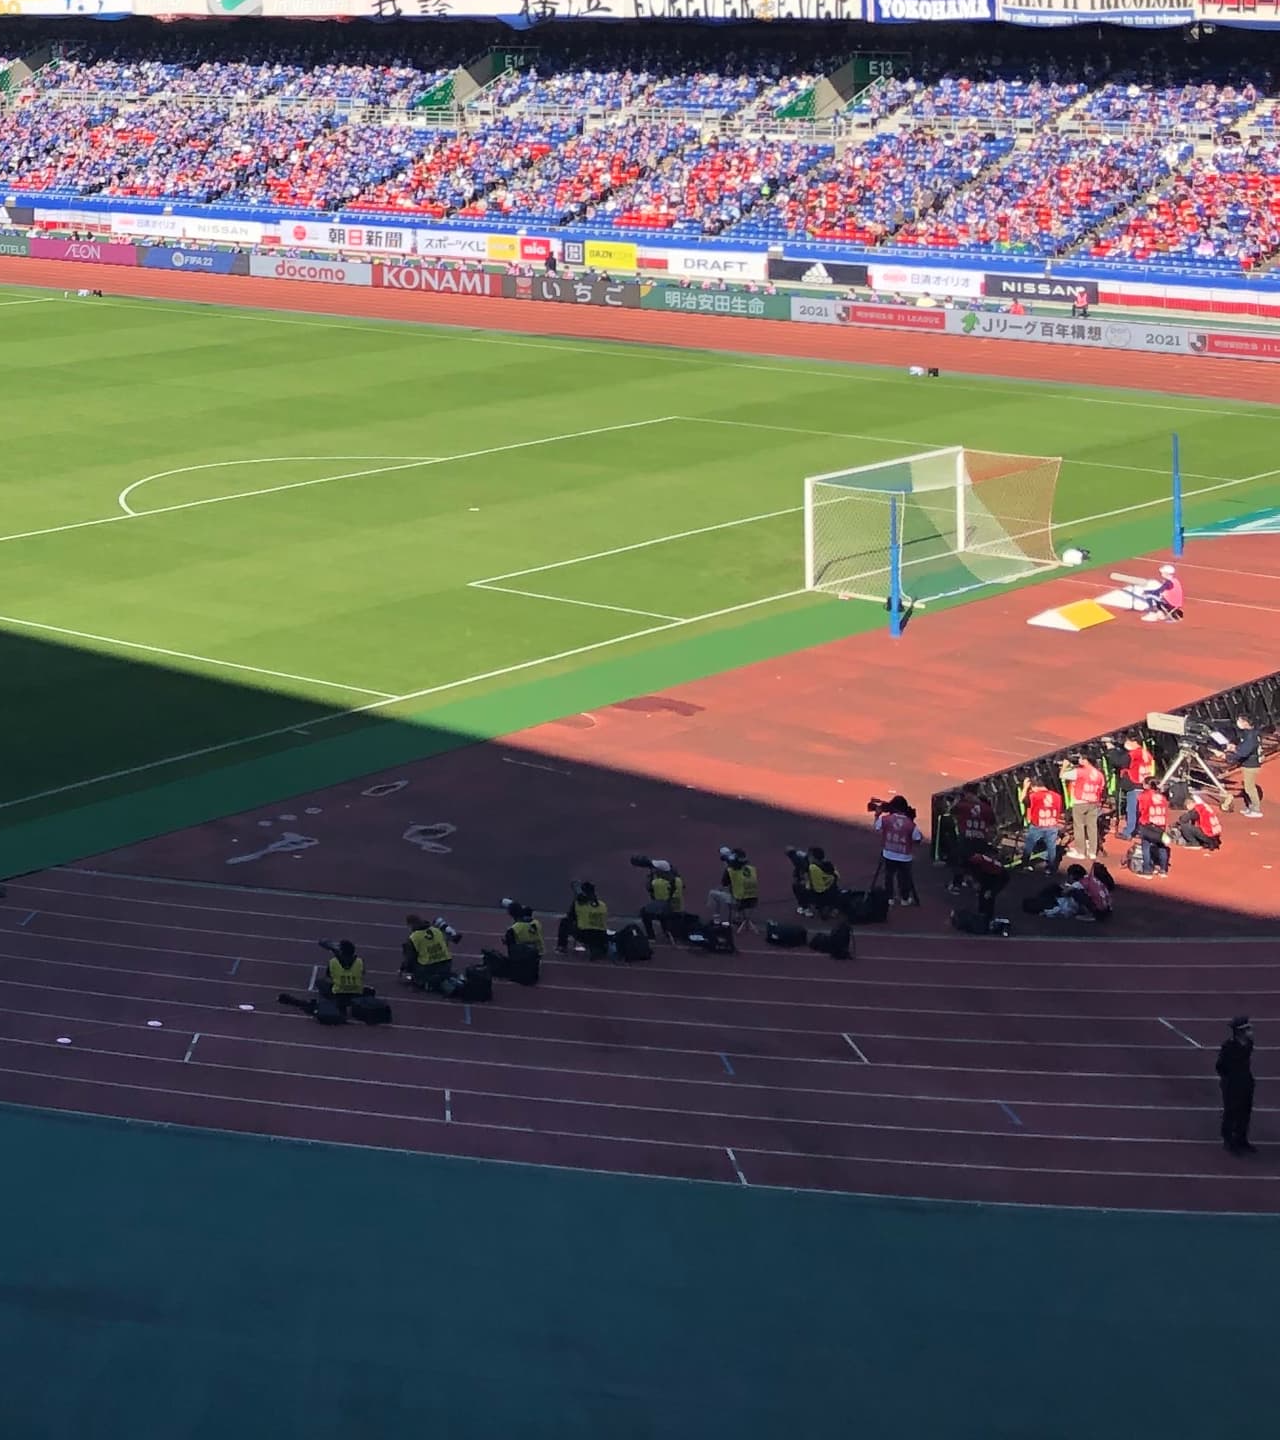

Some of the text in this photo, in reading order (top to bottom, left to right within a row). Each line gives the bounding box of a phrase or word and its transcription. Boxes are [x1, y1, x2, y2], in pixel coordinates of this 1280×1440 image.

[504, 54, 525, 68] E14
[868, 61, 893, 76] E13
[197, 224, 249, 236] NISSAN
[329, 227, 403, 249] 朝日新聞
[275, 260, 345, 281] docomo
[683, 257, 748, 273] DRAFT
[383, 268, 490, 294] KONAMI
[1001, 281, 1080, 297] NISSAN
[542, 282, 624, 306] いちご
[665, 290, 765, 315] 明治安田生命
[799, 304, 829, 317] 2021
[1145, 333, 1181, 347] 2021
